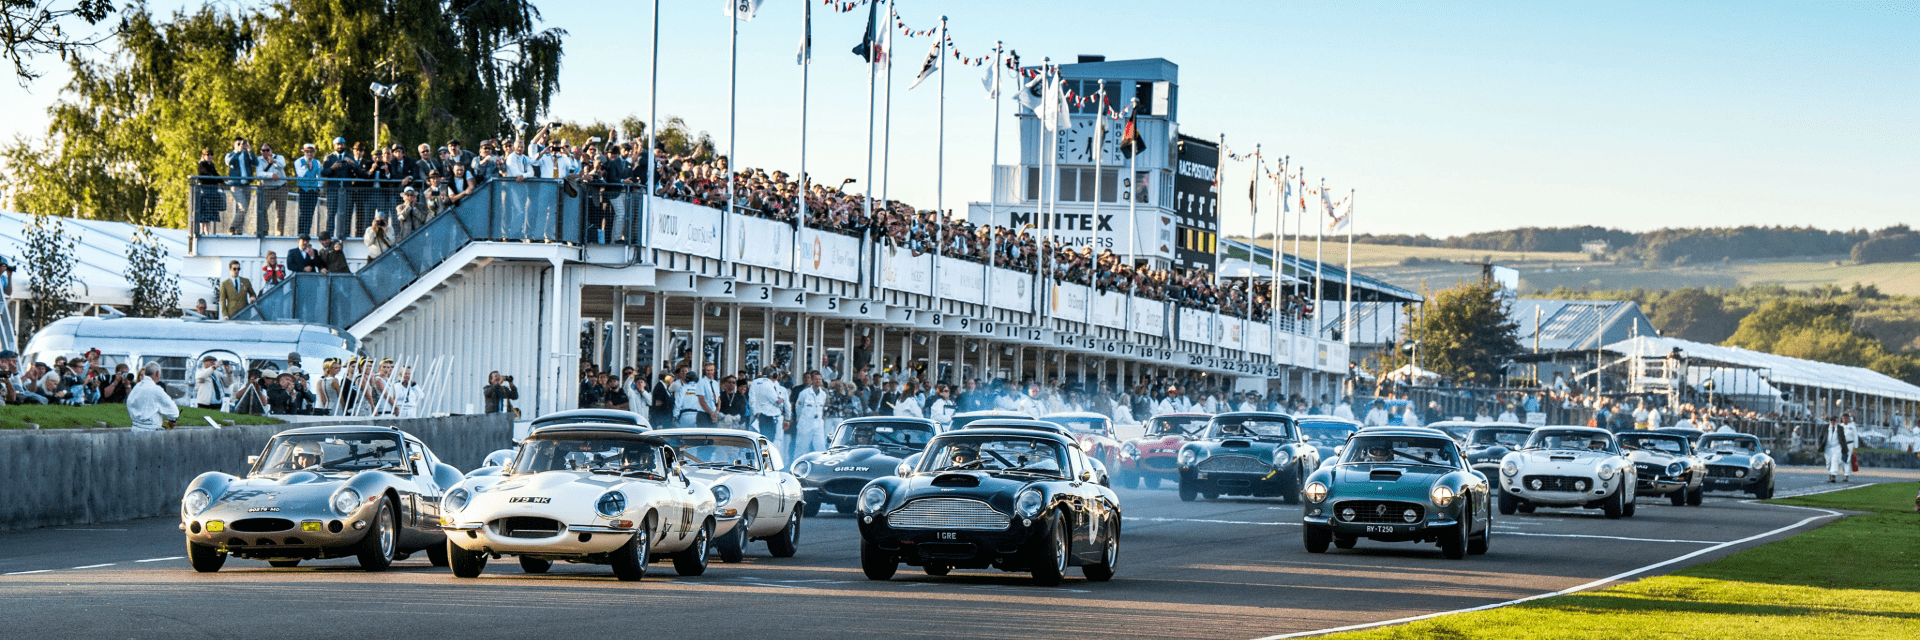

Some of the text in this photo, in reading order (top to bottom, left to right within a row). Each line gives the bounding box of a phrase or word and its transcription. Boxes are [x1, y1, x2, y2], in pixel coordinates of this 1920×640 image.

[1058, 129, 1066, 160] OLEX
[1115, 122, 1123, 161] ROLEX
[1178, 159, 1216, 183] RACE POSITIONS
[1010, 212, 1114, 232] MINTEX
[689, 274, 693, 289] 1
[723, 280, 733, 294] 2
[760, 286, 769, 300] 3
[794, 292, 804, 305] 4
[828, 297, 836, 310] 5
[859, 302, 868, 315] 6
[904, 309, 913, 321] 7
[932, 313, 941, 326] 8
[960, 318, 969, 330] 9
[979, 322, 993, 334] 10
[1006, 326, 1018, 337] 11
[1028, 329, 1041, 341] 12
[1060, 334, 1074, 346] 14
[1082, 338, 1095, 349] 15
[1102, 342, 1115, 352] 16
[1121, 344, 1134, 355] 17
[1140, 347, 1153, 358] 18
[1159, 350, 1172, 360] 19
[1189, 355, 1203, 365] 20
[1208, 358, 1219, 368] 21
[1222, 360, 1235, 370] 22
[1237, 363, 1250, 373] 23
[1251, 365, 1263, 375] 24
[1267, 367, 1279, 377] 25
[941, 532, 957, 540] GRE
